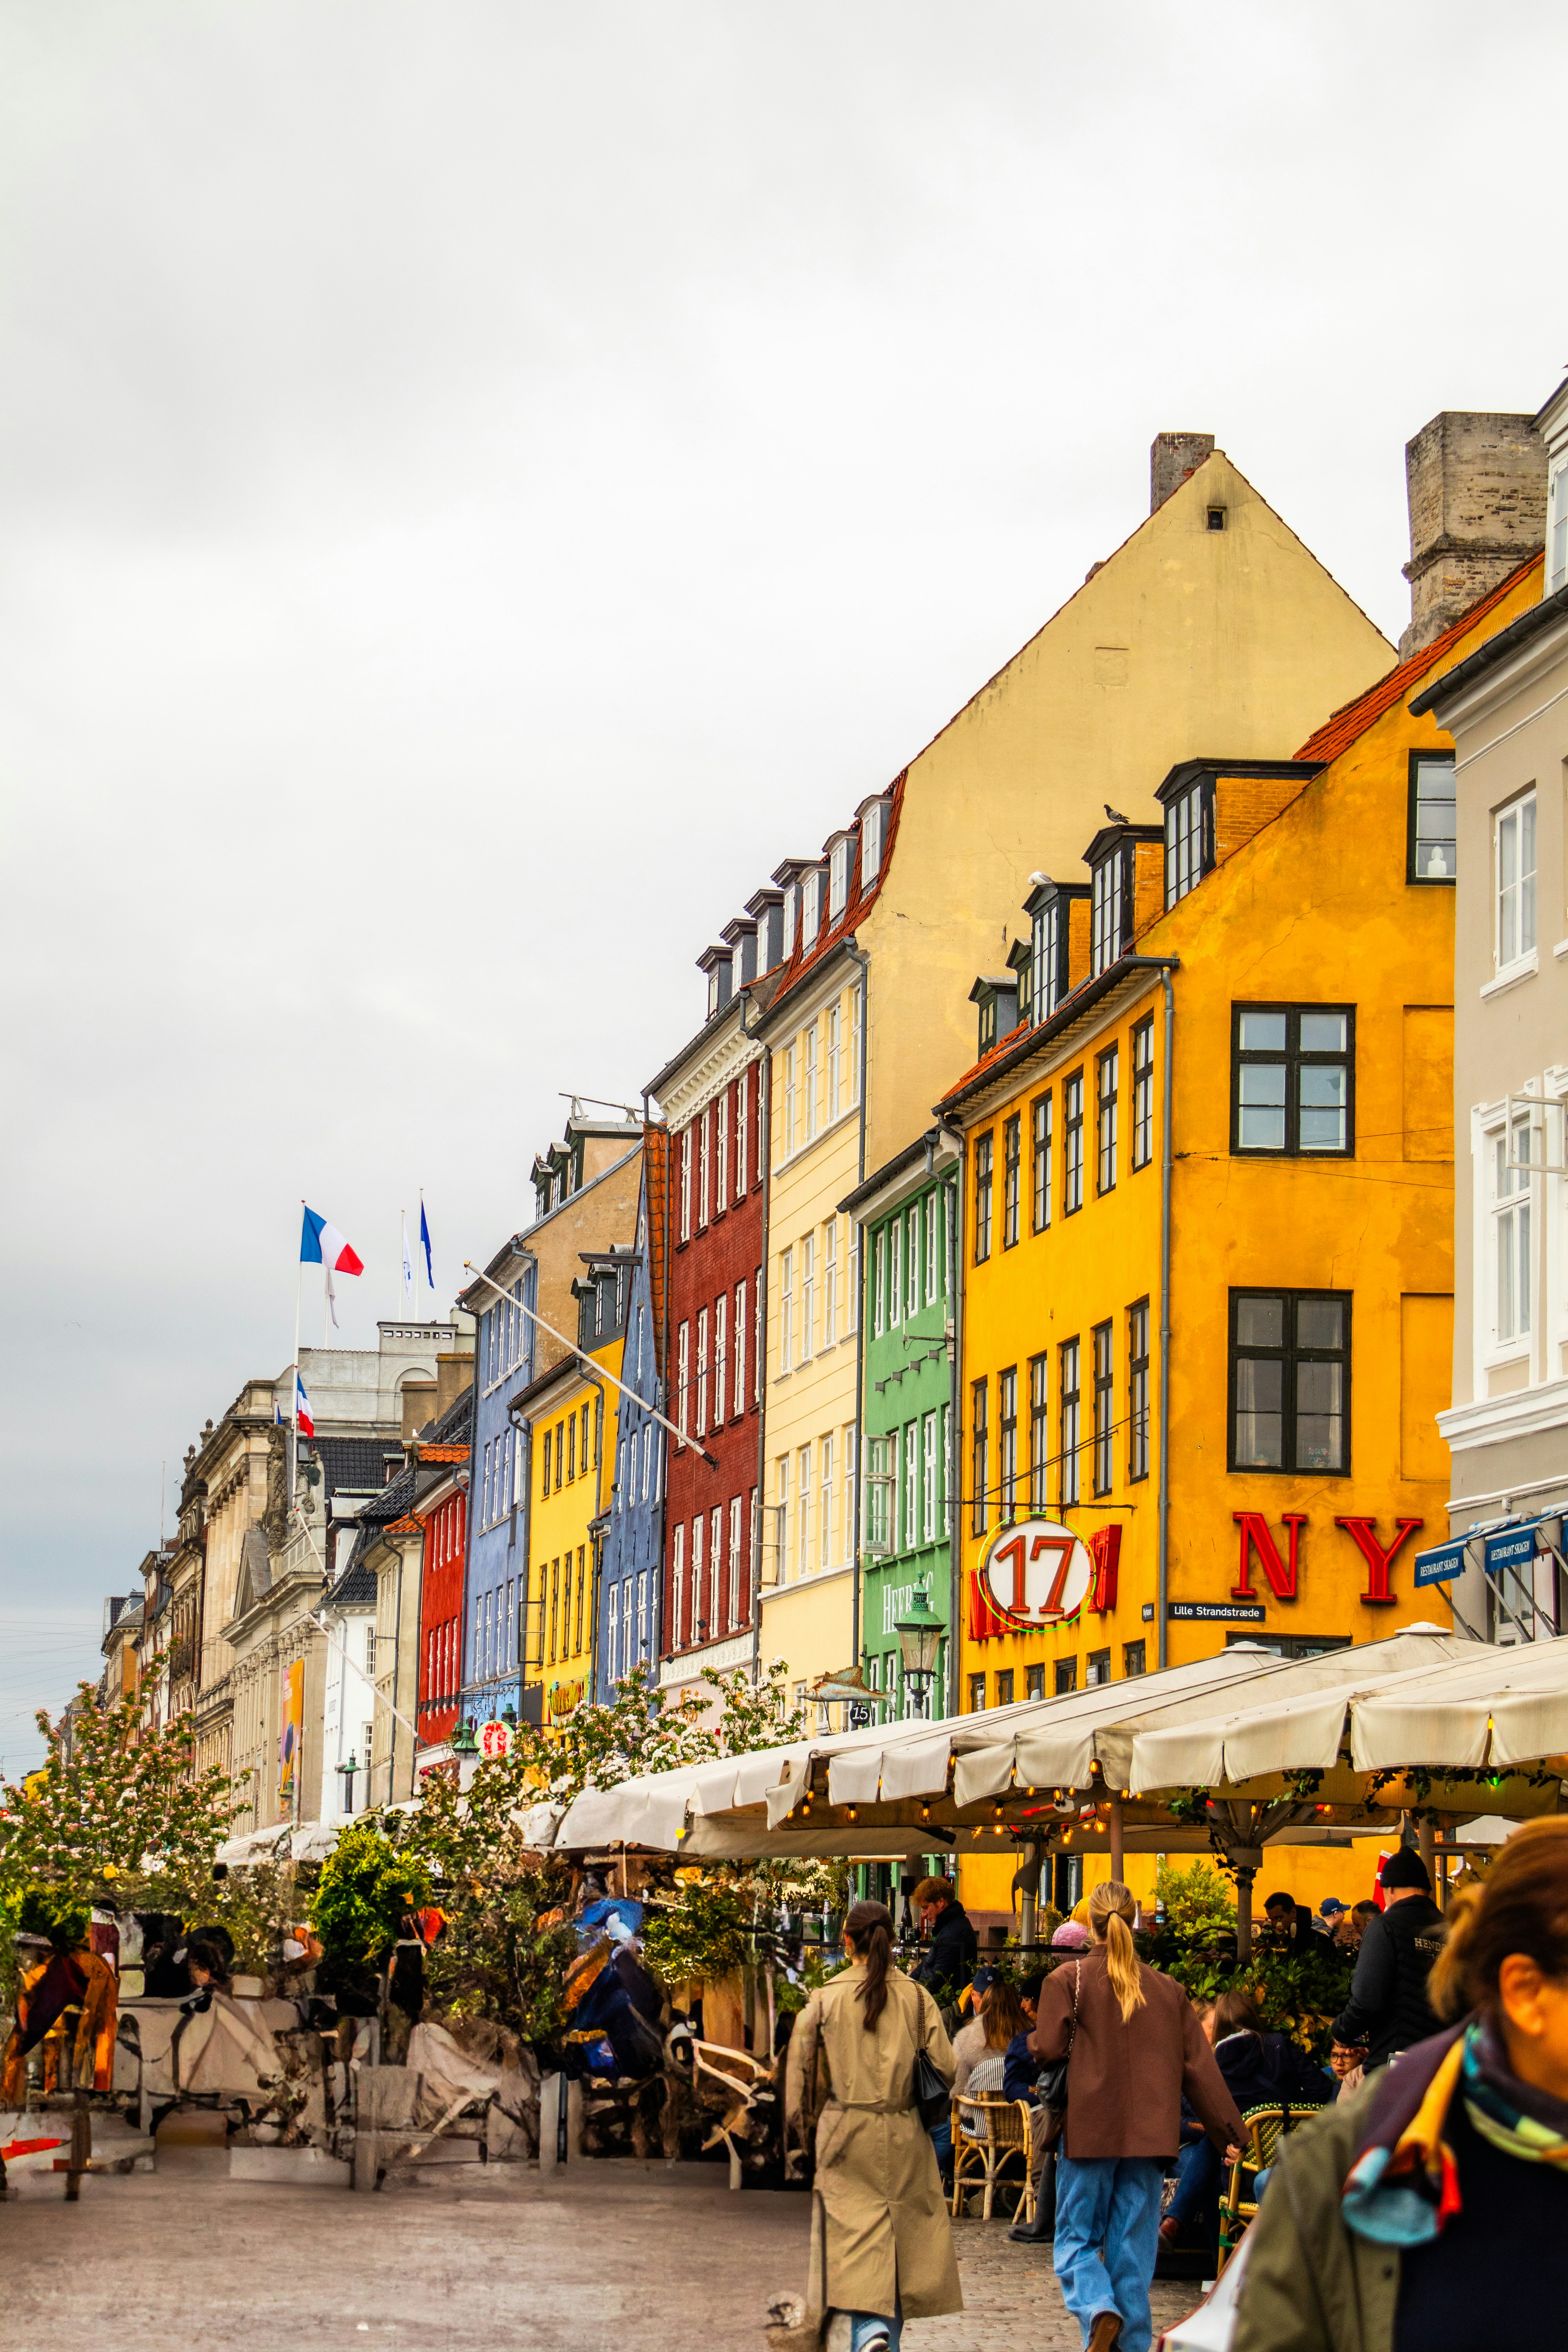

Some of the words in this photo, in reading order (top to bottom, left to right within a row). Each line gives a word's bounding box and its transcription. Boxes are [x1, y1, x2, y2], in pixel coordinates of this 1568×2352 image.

[1491, 1544, 1515, 1561] RESTAURANT
[1514, 1540, 1530, 1555] SKAGEN
[994, 1535, 1076, 1613] 17
[1420, 1561, 1443, 1577] RESTAURANT
[1443, 1557, 1458, 1570] SKAGEN
[1174, 1606, 1193, 1615] Lille
[1196, 1606, 1259, 1617] Strandstræde
